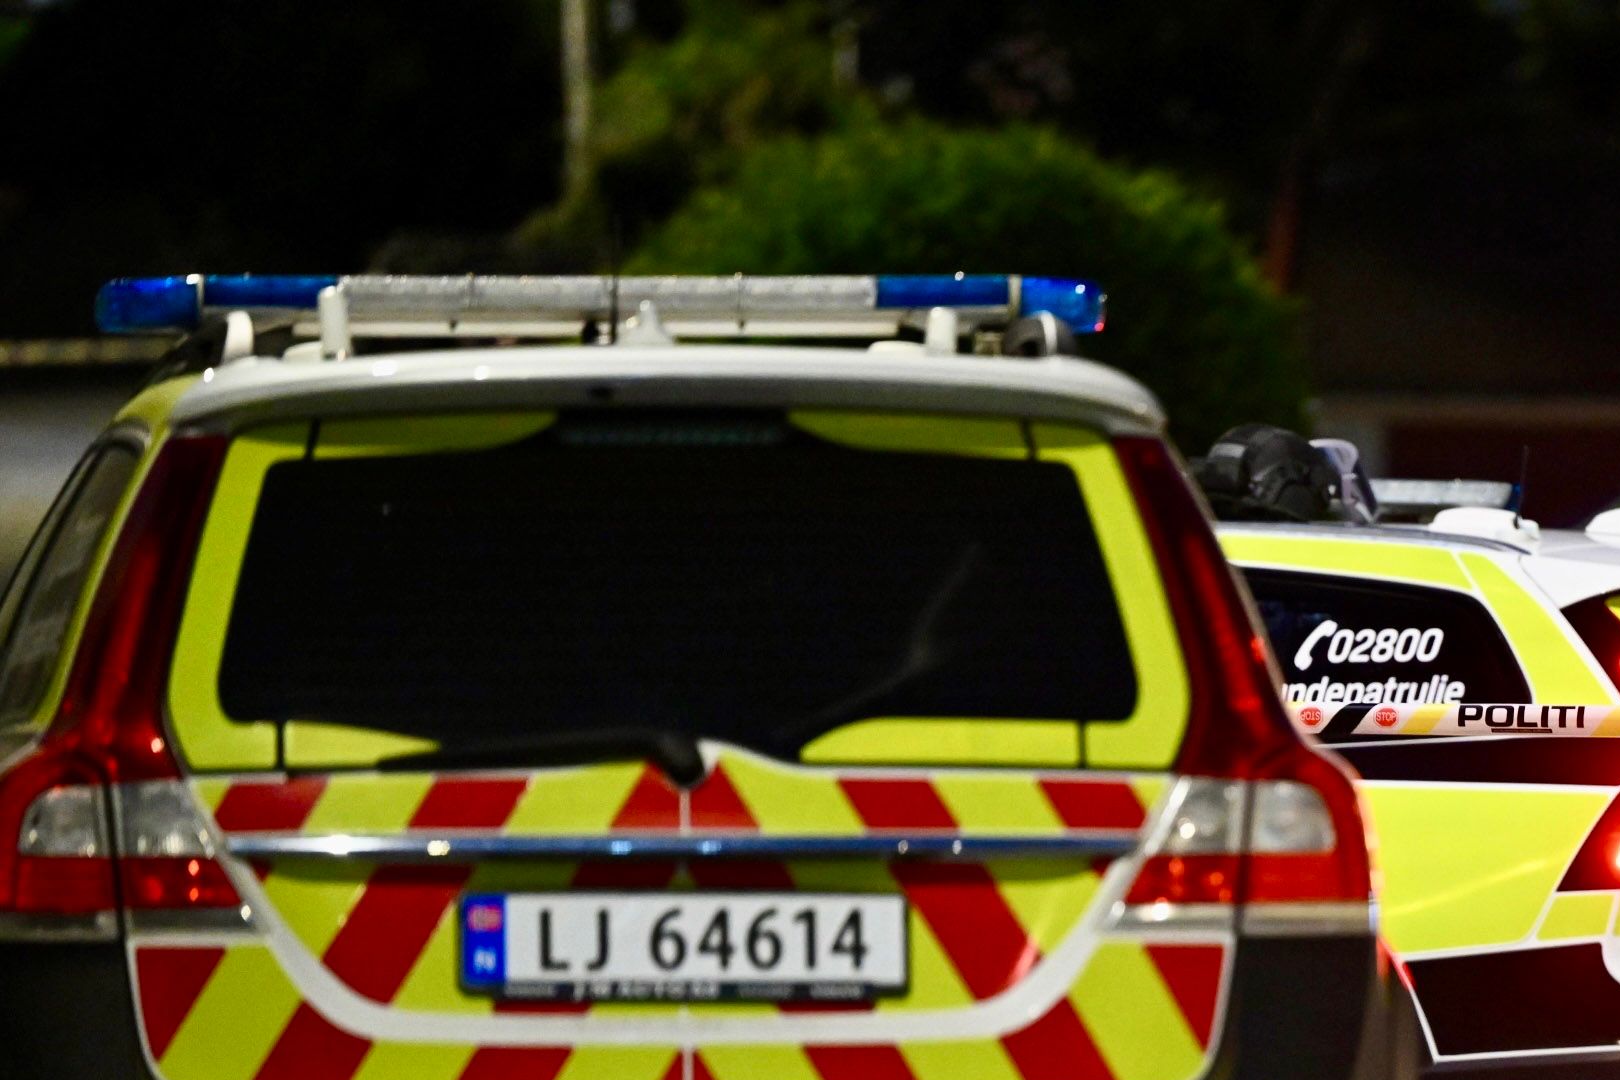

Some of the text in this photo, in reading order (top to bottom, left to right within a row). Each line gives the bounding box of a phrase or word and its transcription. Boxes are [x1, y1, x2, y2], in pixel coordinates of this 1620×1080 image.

[1327, 628, 1444, 664] 02800
[1300, 709, 1321, 721] STOP
[1376, 709, 1397, 721] STOP
[1457, 705, 1586, 728] POLITI
[539, 908, 868, 970] LJ 64614
